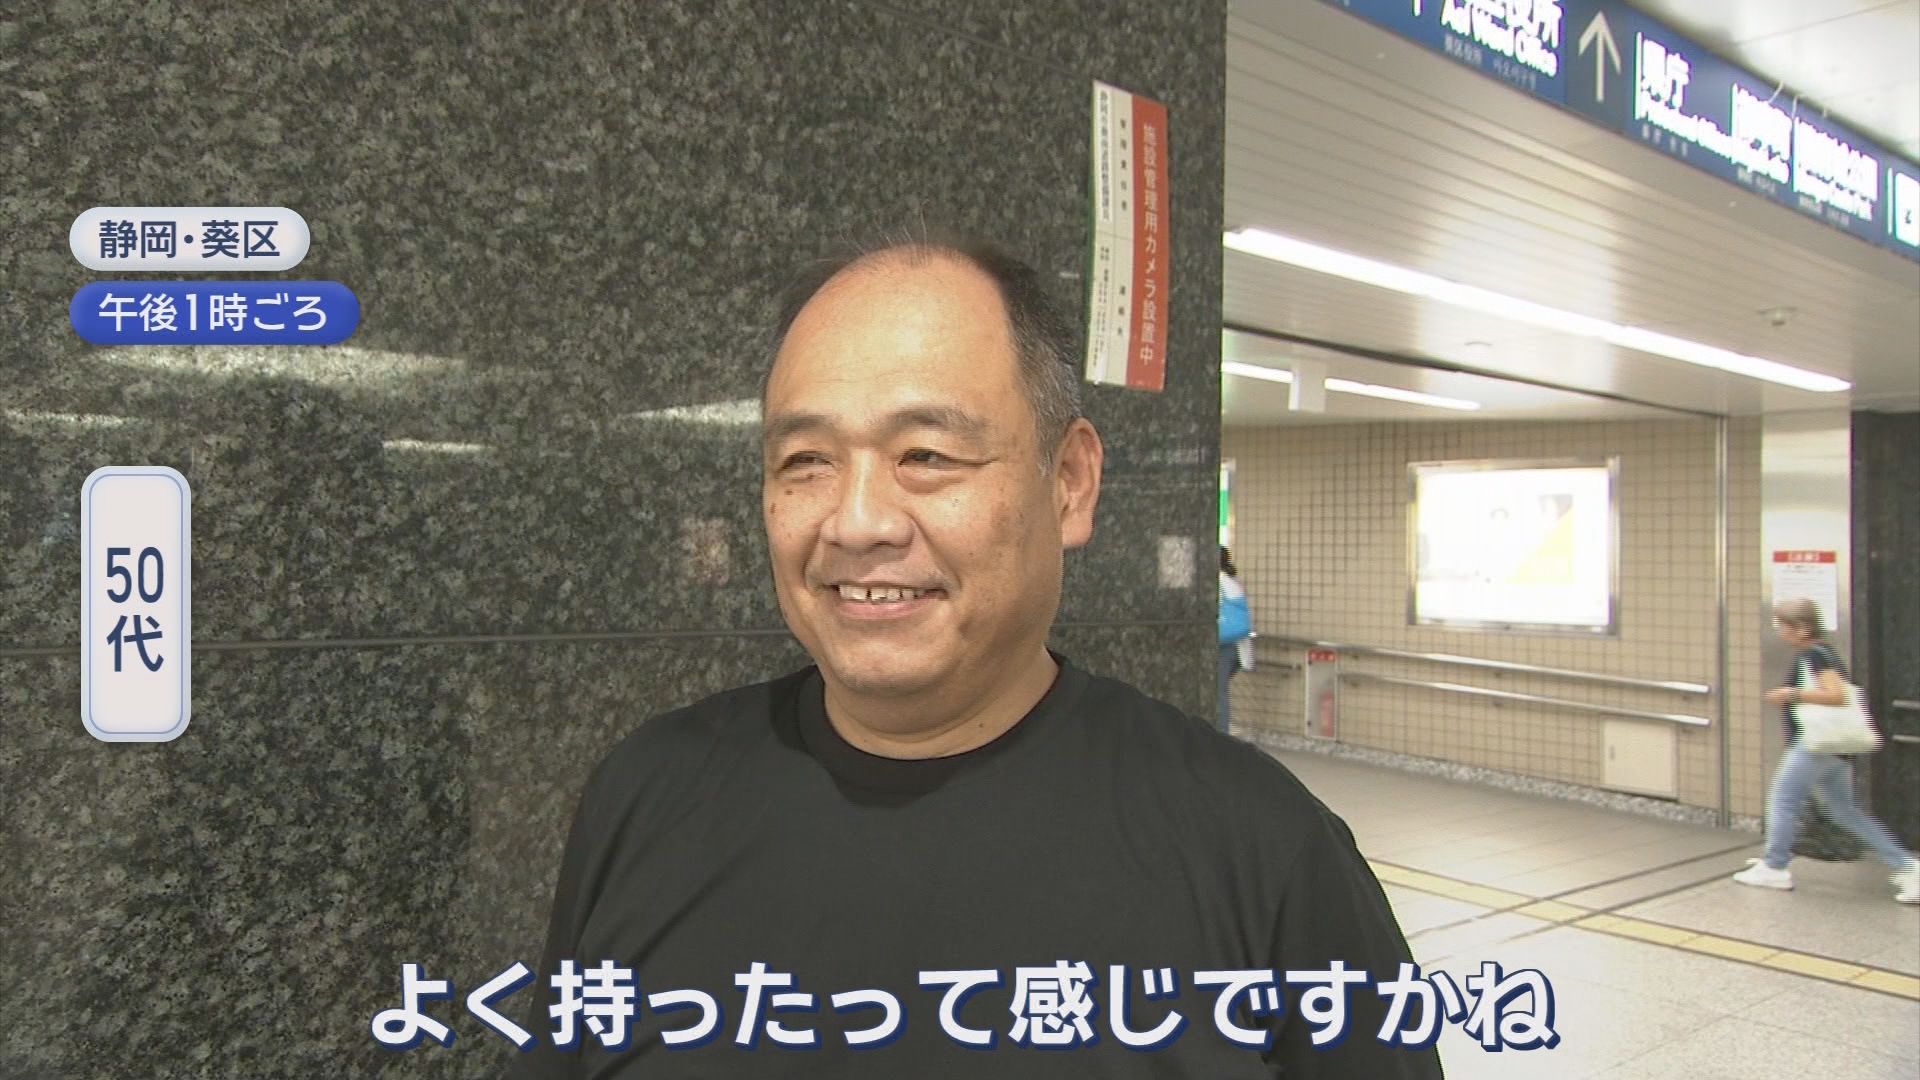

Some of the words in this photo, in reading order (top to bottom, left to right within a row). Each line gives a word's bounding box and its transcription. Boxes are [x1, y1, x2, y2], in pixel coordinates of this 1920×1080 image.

[1139, 122, 1159, 367] 施設管理用カメラ設置中
